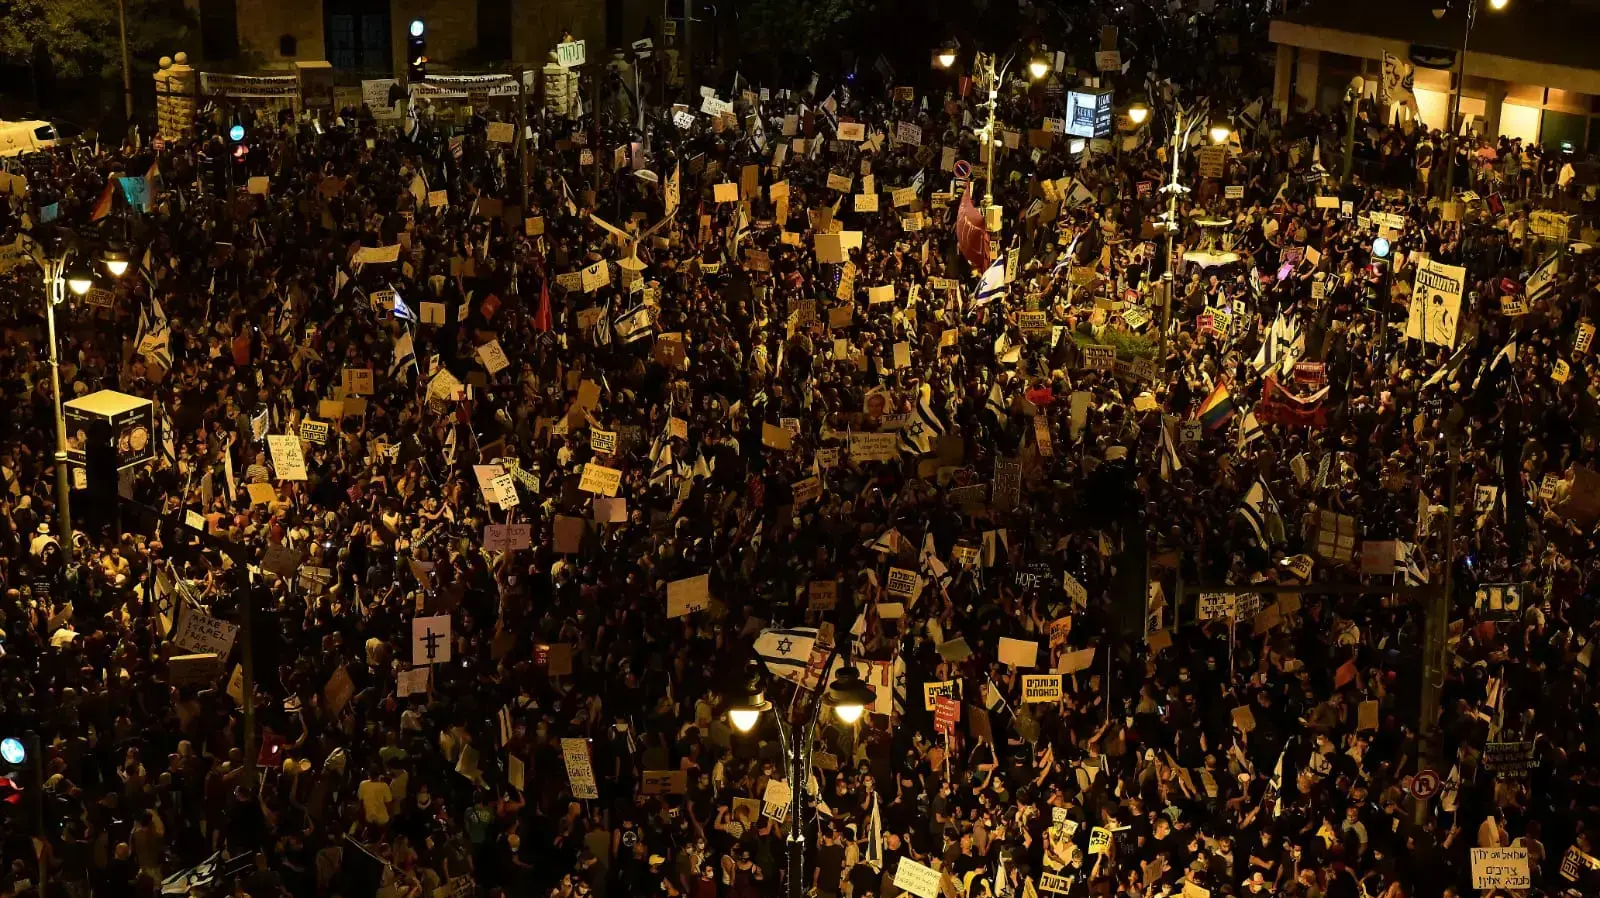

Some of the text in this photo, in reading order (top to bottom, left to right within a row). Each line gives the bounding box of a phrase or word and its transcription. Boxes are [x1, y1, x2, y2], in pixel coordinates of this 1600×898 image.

[1015, 571, 1042, 589] HOPE
[1027, 679, 1059, 688] מנותקים
[1027, 688, 1059, 697] נמאסתם
[1485, 866, 1518, 876] צריכים
[1041, 875, 1068, 893] בושה
